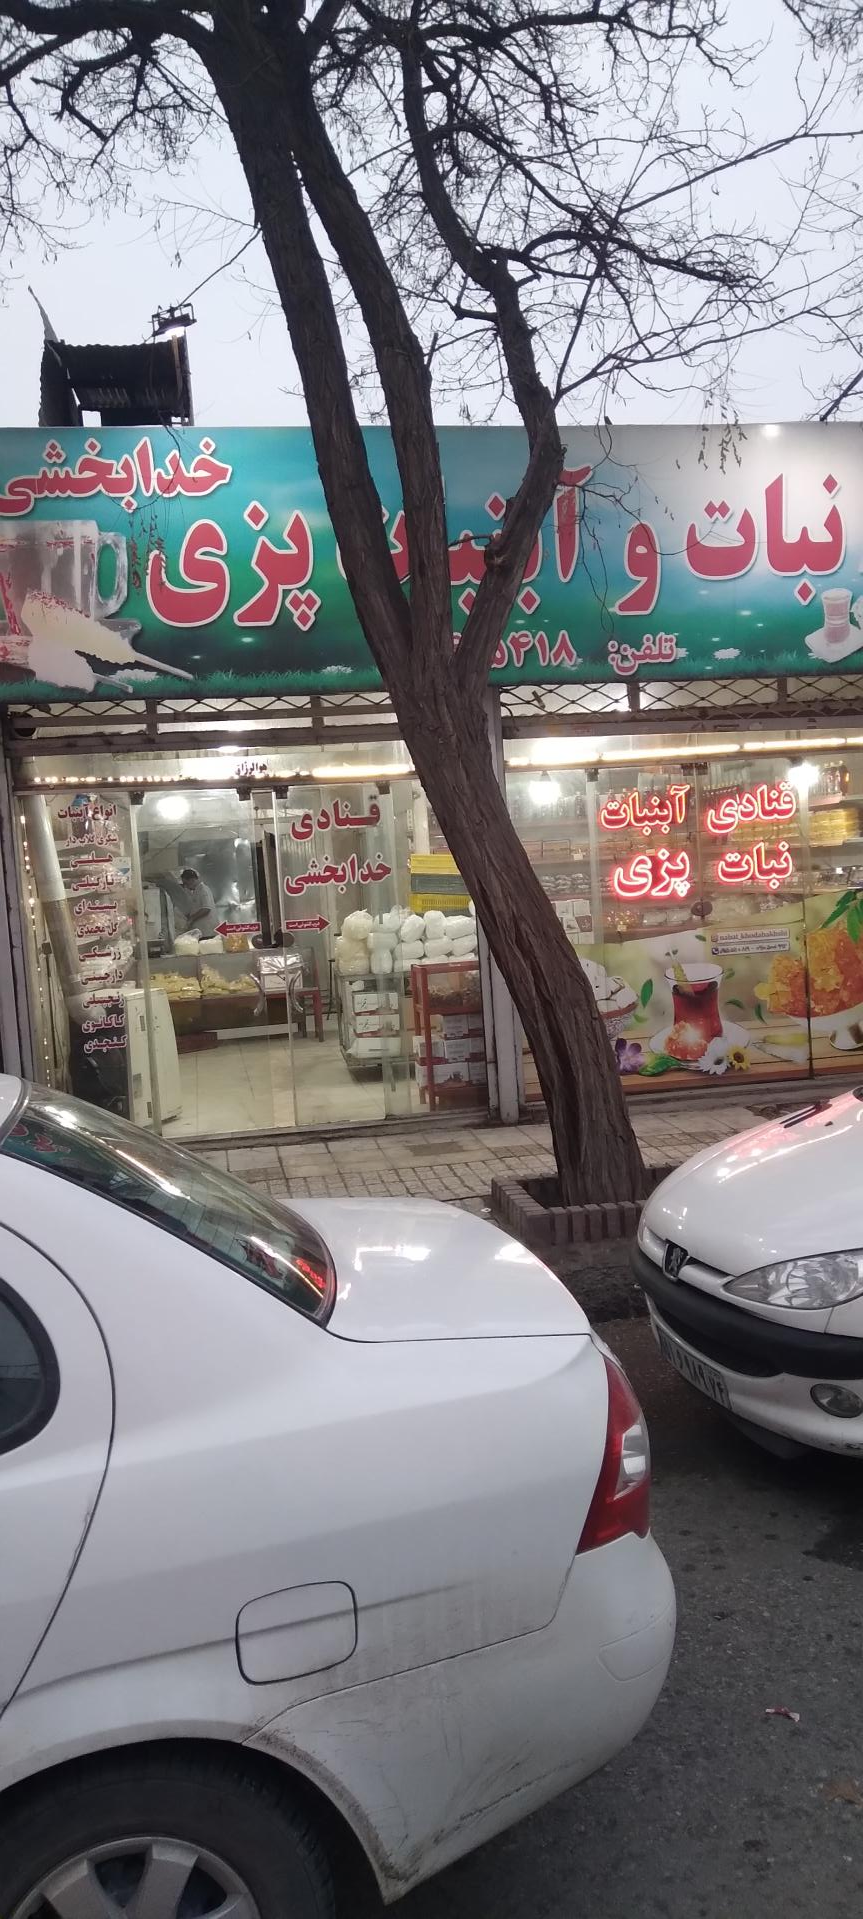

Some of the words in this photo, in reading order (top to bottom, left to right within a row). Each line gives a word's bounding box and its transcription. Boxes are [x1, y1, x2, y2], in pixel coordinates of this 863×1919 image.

[0, 437, 232, 516] خدابخشی
[685, 472, 847, 607] نبات
[146, 501, 321, 631] پزی
[613, 520, 662, 616] و
[57, 803, 89, 822] آبنبات
[91, 802, 117, 821] انواع
[290, 794, 381, 840] قنادی
[600, 784, 690, 836] آبنبات
[707, 781, 796, 834] قنادی
[284, 852, 392, 896] خدابخشی
[613, 847, 690, 898] پزی
[717, 841, 793, 890] نبات
[76, 924, 106, 938] محمدی
[78, 945, 122, 962] زرشکی
[80, 968, 124, 986] دارچینی
[83, 1034, 128, 1054] کنجدی
